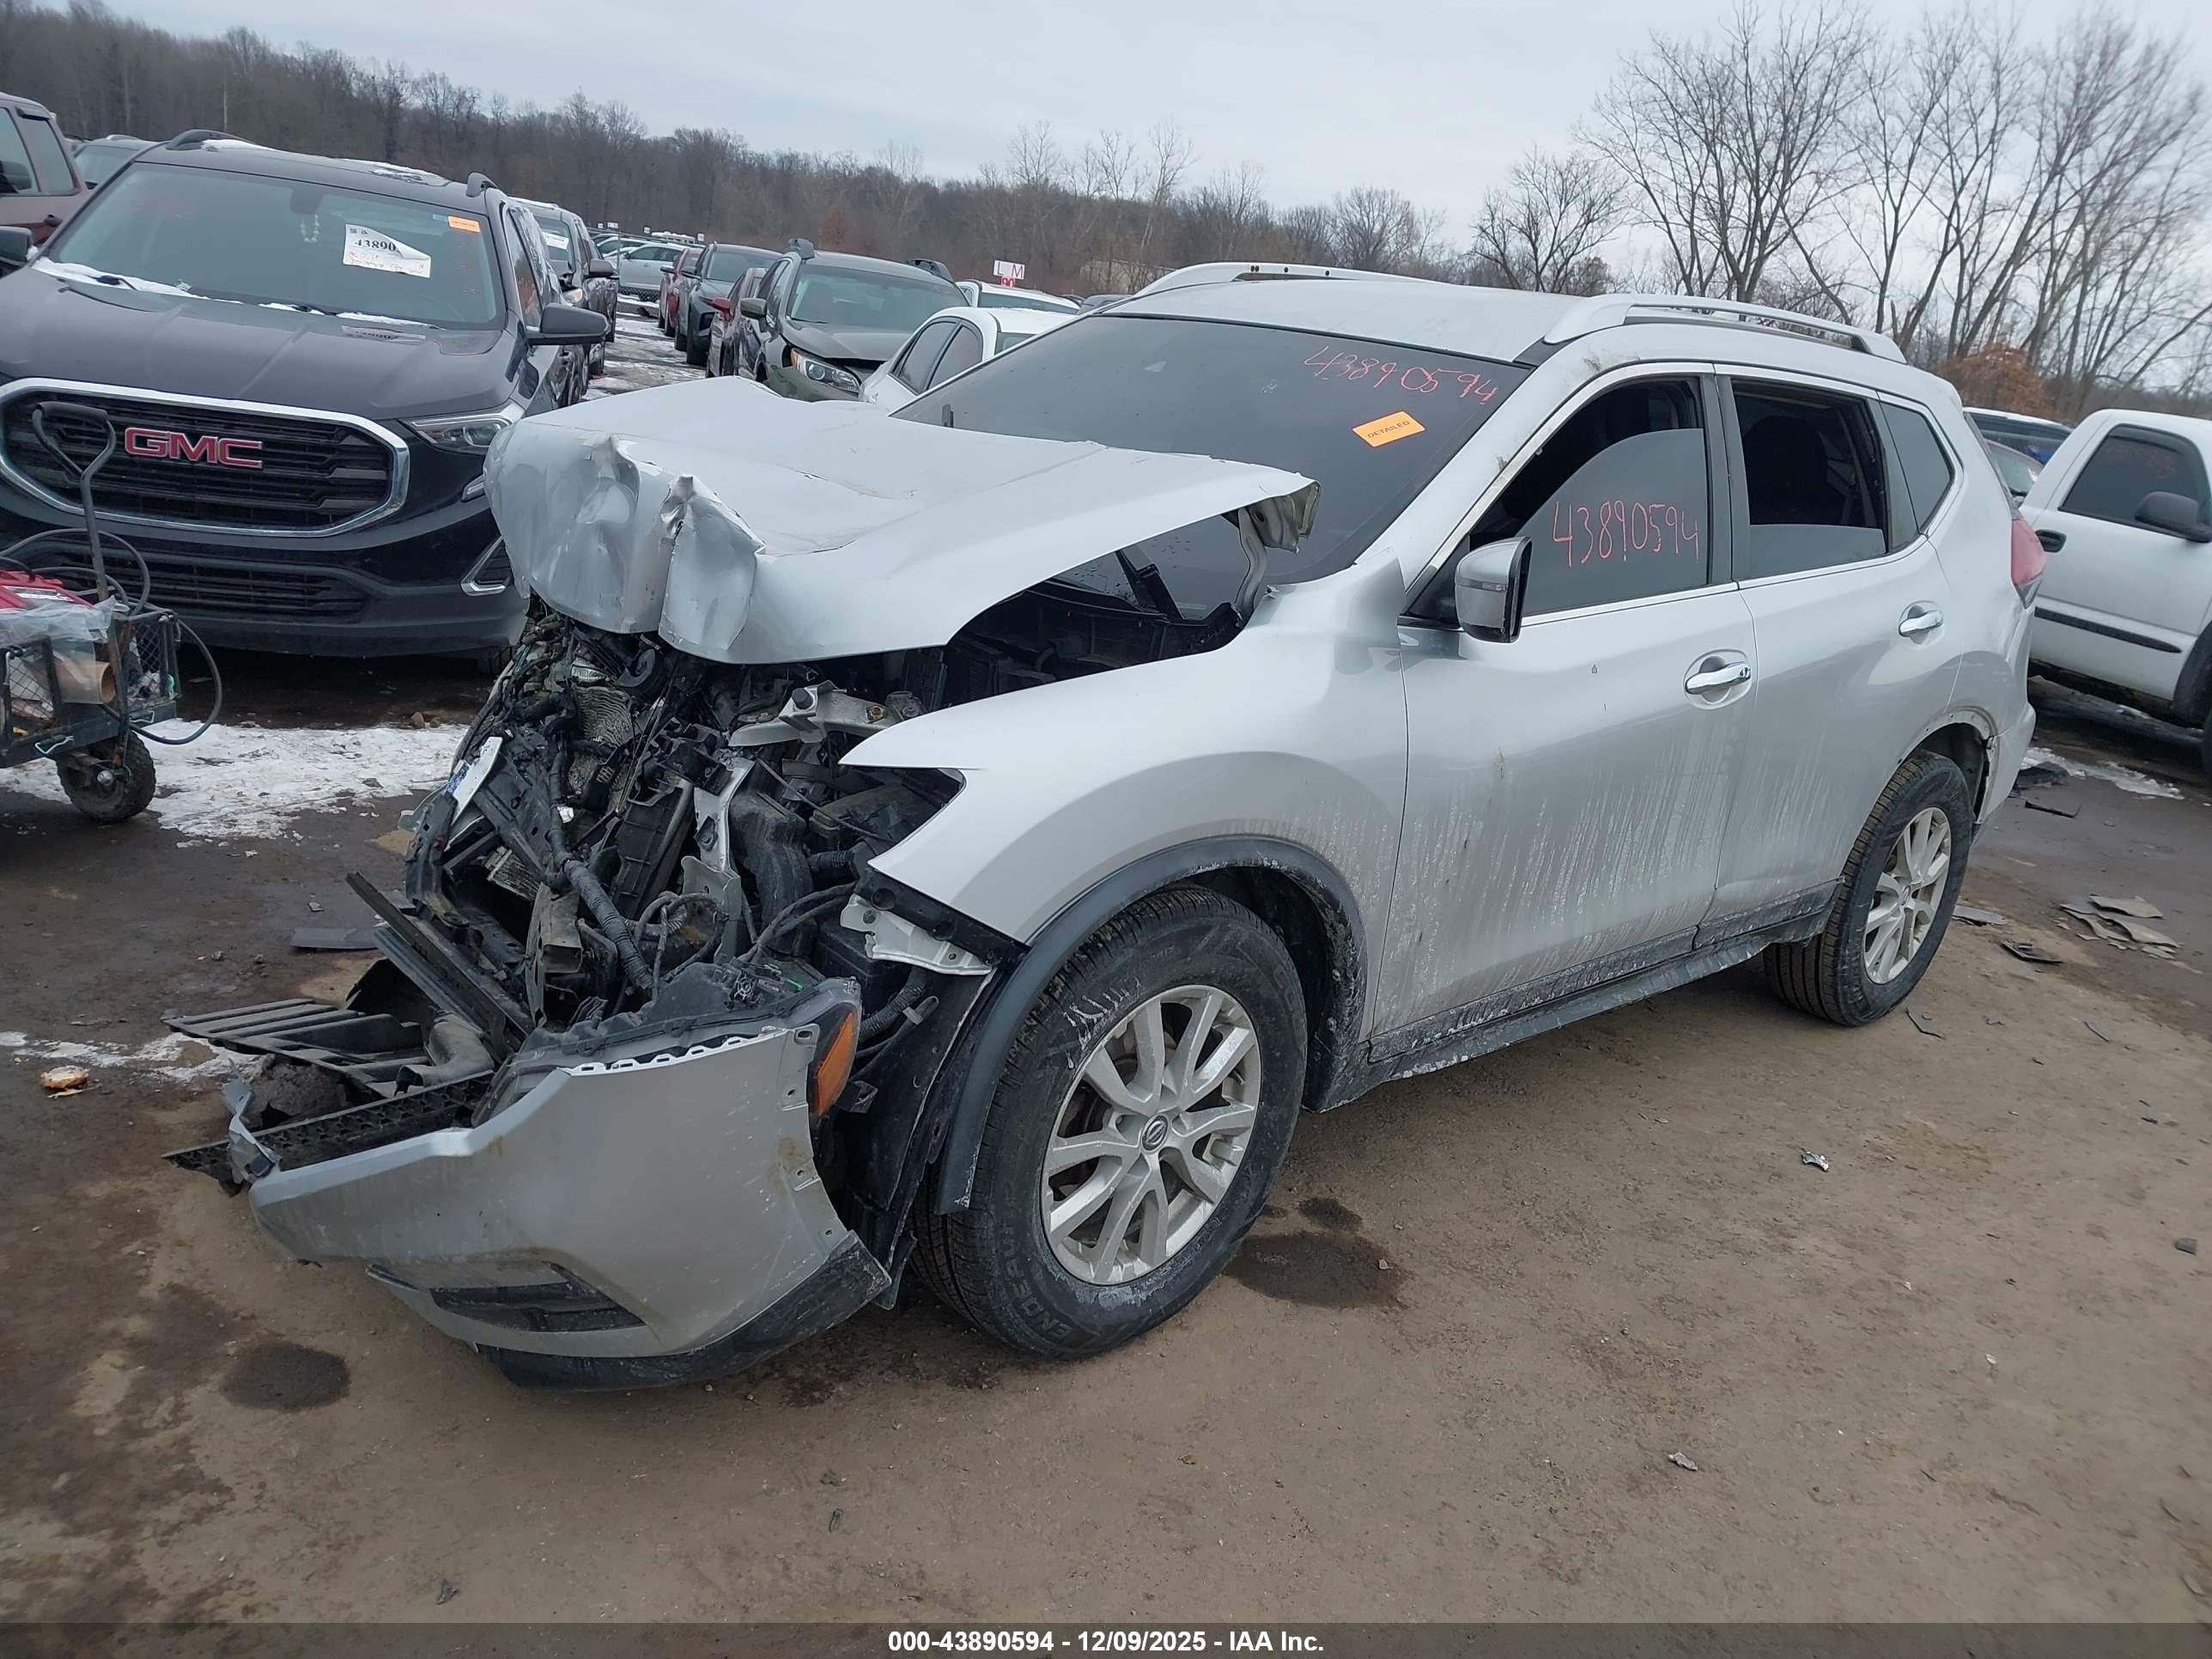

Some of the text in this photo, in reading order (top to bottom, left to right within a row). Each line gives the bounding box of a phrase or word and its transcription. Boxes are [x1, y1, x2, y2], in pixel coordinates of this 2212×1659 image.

[1304, 345, 1498, 404] 43890594
[125, 427, 263, 469] GMC
[1367, 420, 1410, 439] DETAILED
[1553, 501, 1699, 567] 43890594
